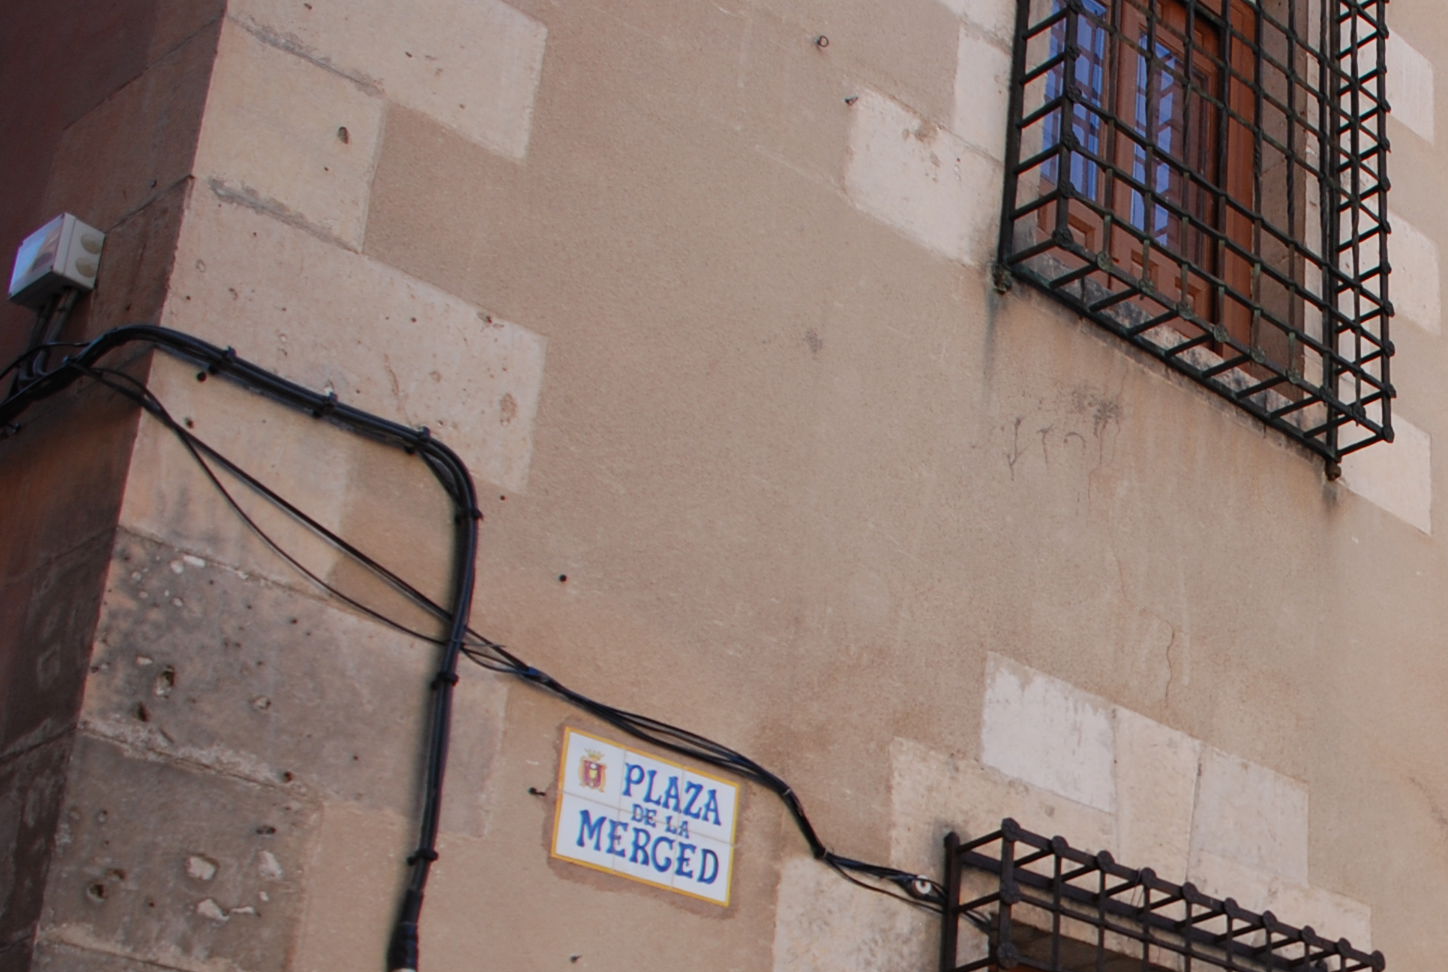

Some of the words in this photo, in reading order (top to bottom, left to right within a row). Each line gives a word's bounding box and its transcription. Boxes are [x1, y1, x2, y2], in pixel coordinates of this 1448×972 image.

[622, 762, 721, 826] PLAZA
[631, 803, 657, 828] DE
[665, 815, 690, 839] LA
[576, 809, 719, 885] MERCED
